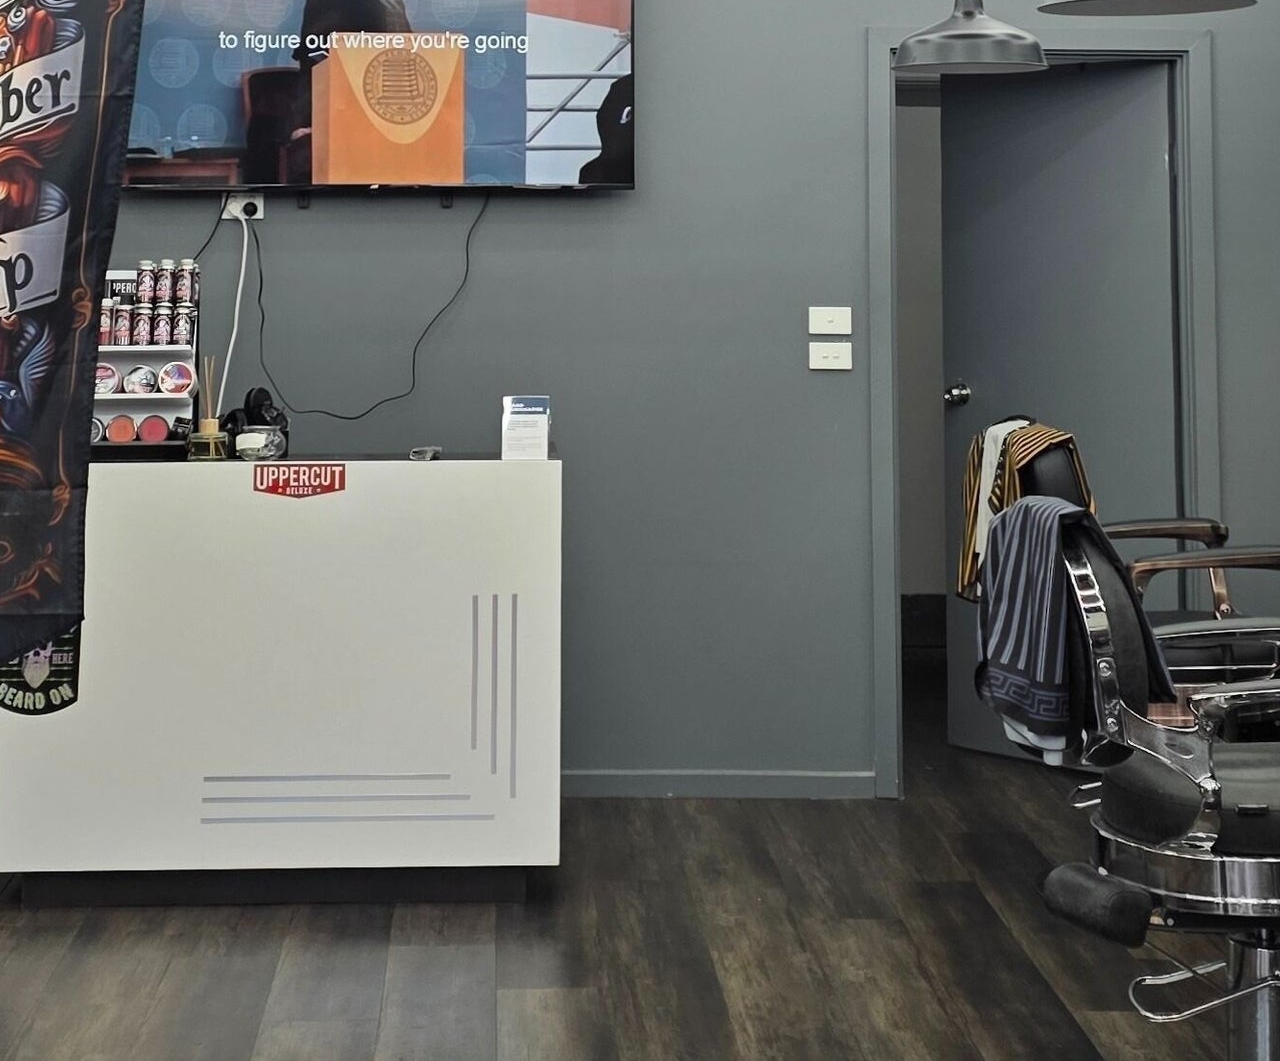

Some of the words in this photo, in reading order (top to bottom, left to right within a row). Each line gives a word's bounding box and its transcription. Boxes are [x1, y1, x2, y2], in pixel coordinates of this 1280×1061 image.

[218, 31, 238, 49] to
[244, 30, 301, 53] figure
[305, 31, 338, 49] out
[343, 30, 405, 49] where
[410, 31, 470, 53] you're
[474, 31, 529, 54] going
[256, 466, 343, 490] UPPERCUT
[286, 486, 313, 495] DELUXE
[52, 652, 74, 664] HERE
[49, 683, 74, 706] ON
